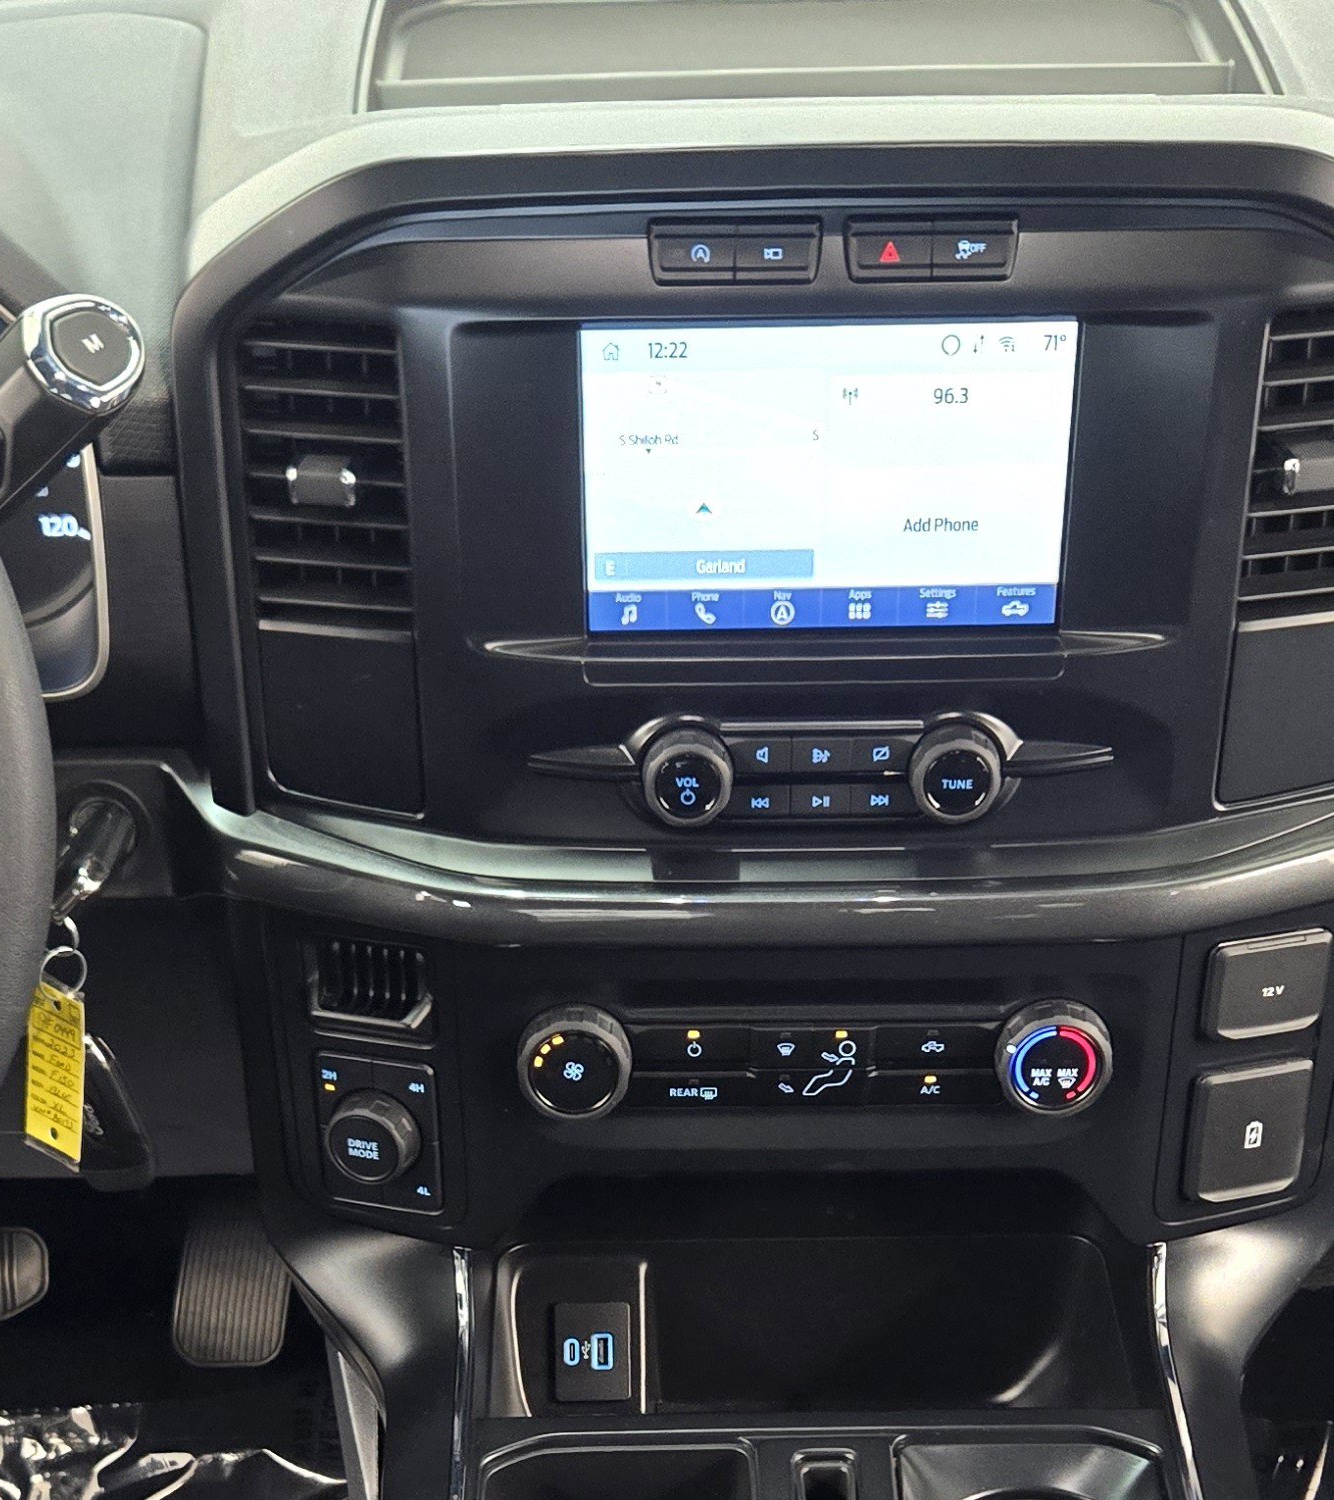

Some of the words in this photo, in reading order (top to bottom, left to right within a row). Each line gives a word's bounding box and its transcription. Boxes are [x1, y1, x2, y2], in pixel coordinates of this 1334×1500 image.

[80, 333, 105, 354] M
[1043, 334, 1066, 351] 71°
[648, 341, 688, 359] 12:22
[933, 387, 969, 404] 96.3
[38, 515, 79, 538] 120
[903, 519, 931, 532] Add
[934, 517, 979, 532] Phone
[696, 558, 746, 574] Garland
[691, 591, 719, 602] Phone
[773, 590, 792, 601] Nav
[848, 589, 872, 600] Apps
[919, 588, 957, 599] Settings
[996, 586, 1036, 597] Features
[675, 777, 700, 789] VOL
[941, 778, 973, 791] TUNE
[321, 1069, 337, 1081] 2H
[1030, 1068, 1053, 1077] MAX
[1056, 1068, 1079, 1077] MAX
[1032, 1077, 1051, 1086] A/C
[408, 1082, 425, 1094] 4H
[669, 1088, 698, 1097] REAR
[920, 1085, 941, 1095] A/C
[347, 1137, 379, 1151] DRIVE
[347, 1148, 380, 1161] MODE
[416, 1186, 431, 1197] 4L
